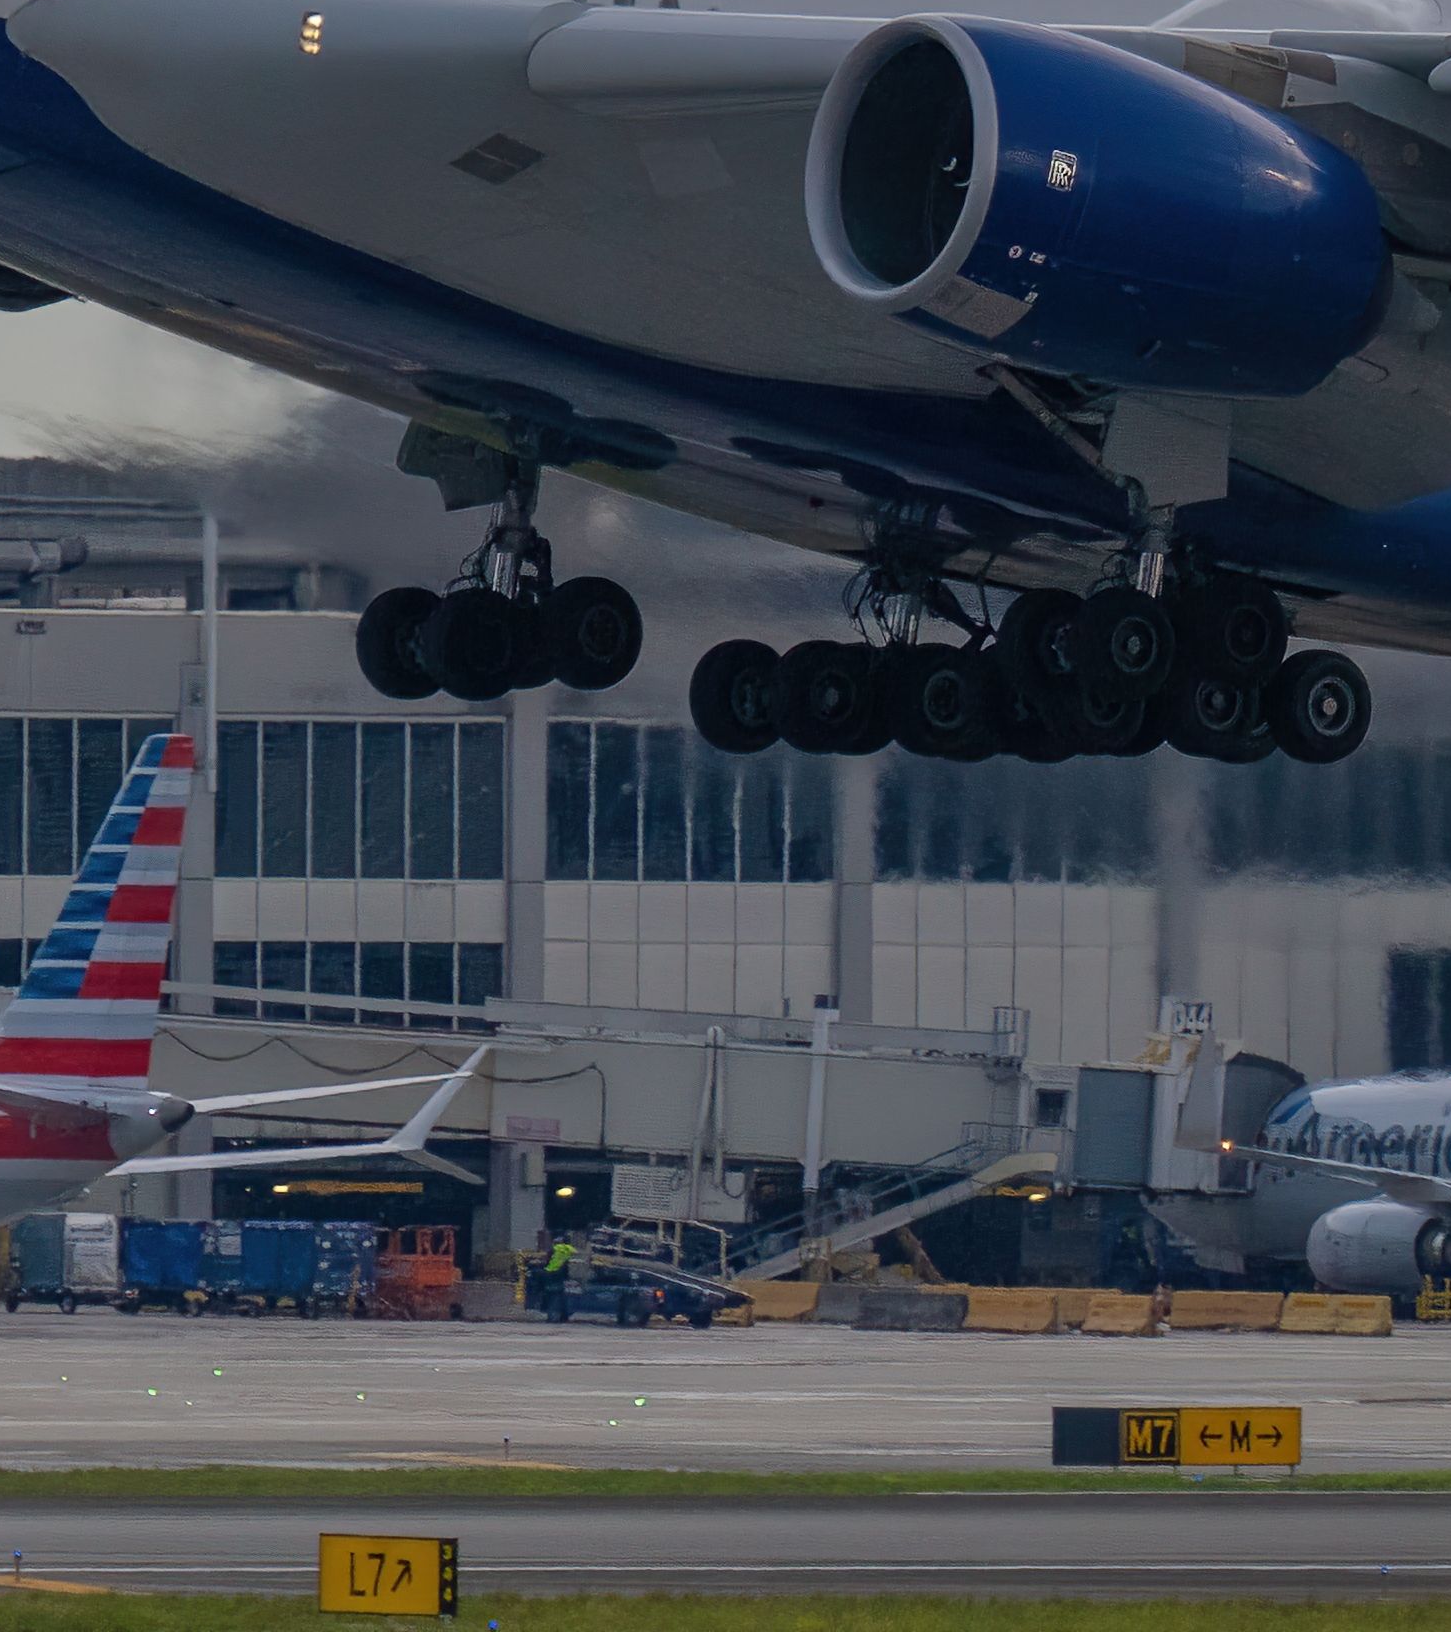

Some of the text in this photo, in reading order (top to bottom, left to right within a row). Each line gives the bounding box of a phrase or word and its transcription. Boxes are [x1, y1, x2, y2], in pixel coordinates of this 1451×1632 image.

[1129, 1419, 1251, 1455] M7 M
[350, 1552, 385, 1596] L7
